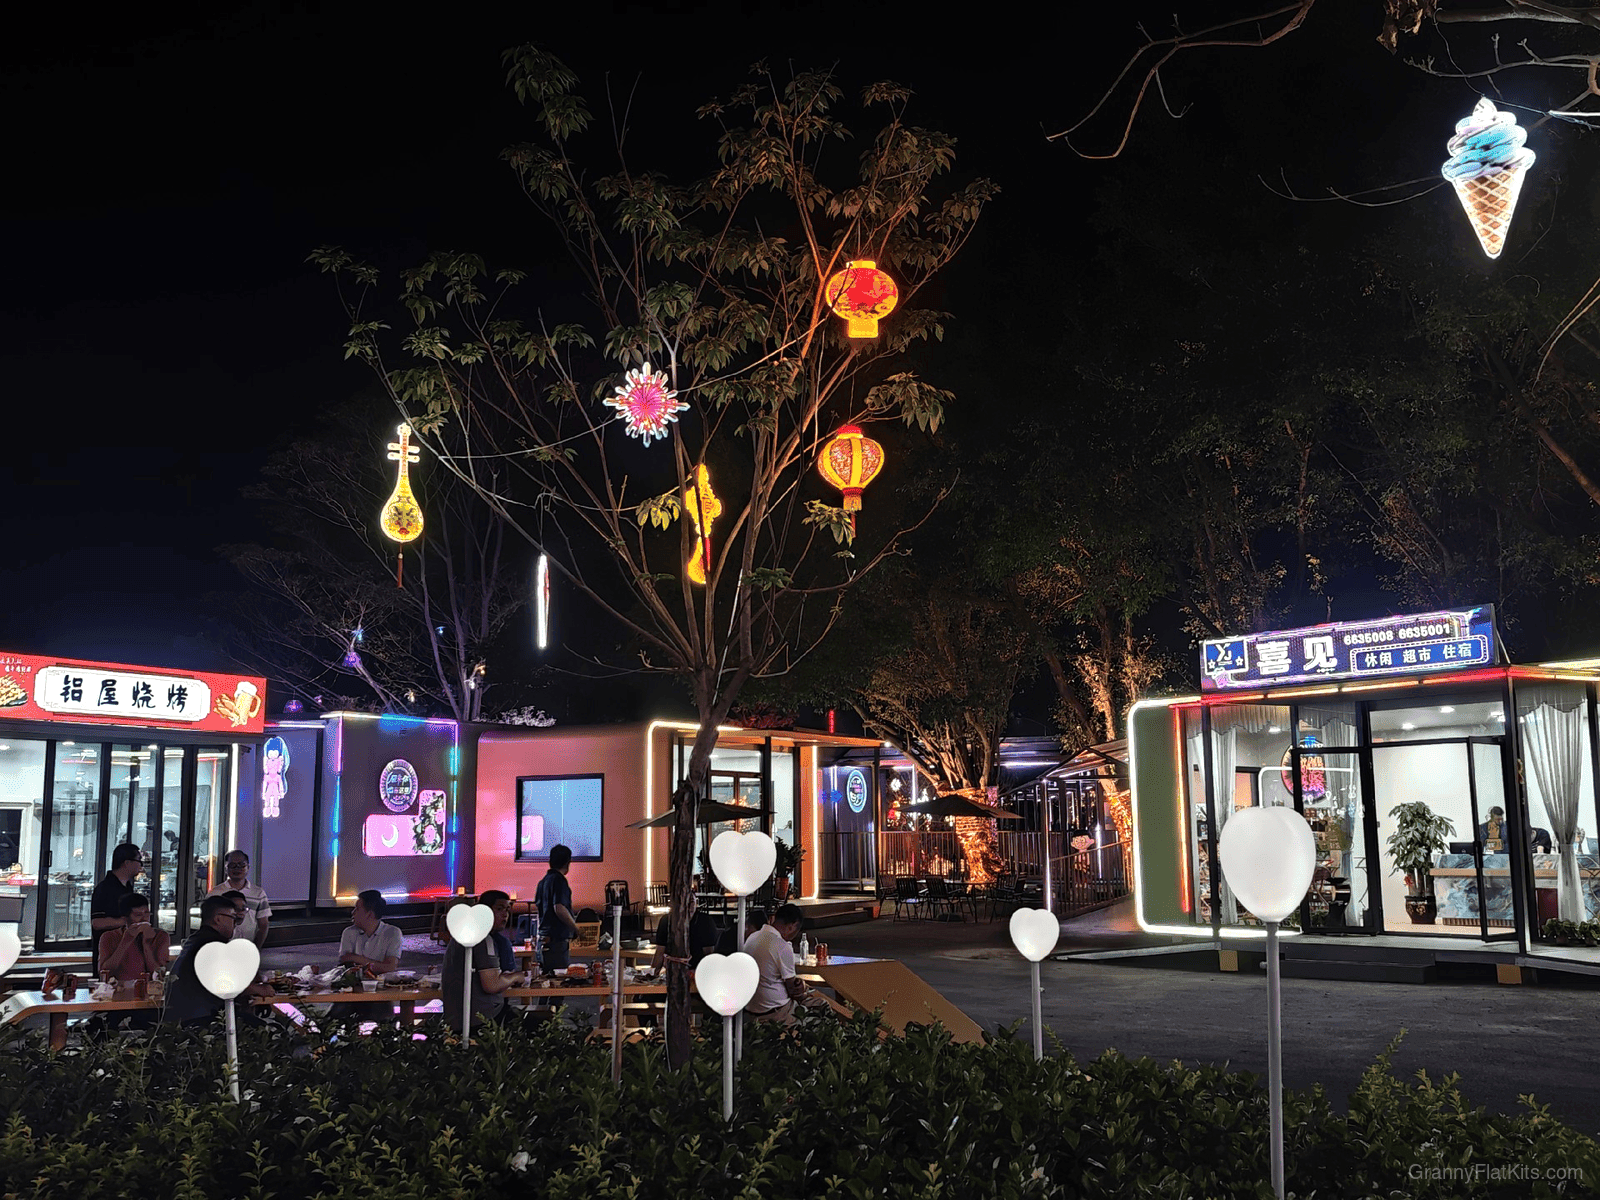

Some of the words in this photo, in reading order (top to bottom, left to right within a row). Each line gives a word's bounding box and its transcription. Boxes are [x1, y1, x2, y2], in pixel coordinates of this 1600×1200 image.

[1343, 631, 1393, 646] 6635008
[1399, 624, 1450, 639] 6635001
[1256, 635, 1338, 675] 喜见
[1365, 652, 1392, 668] 休闲
[1403, 648, 1431, 664] 超市
[1443, 643, 1472, 659] 住宿
[60, 674, 188, 713] 铝屋烧烤
